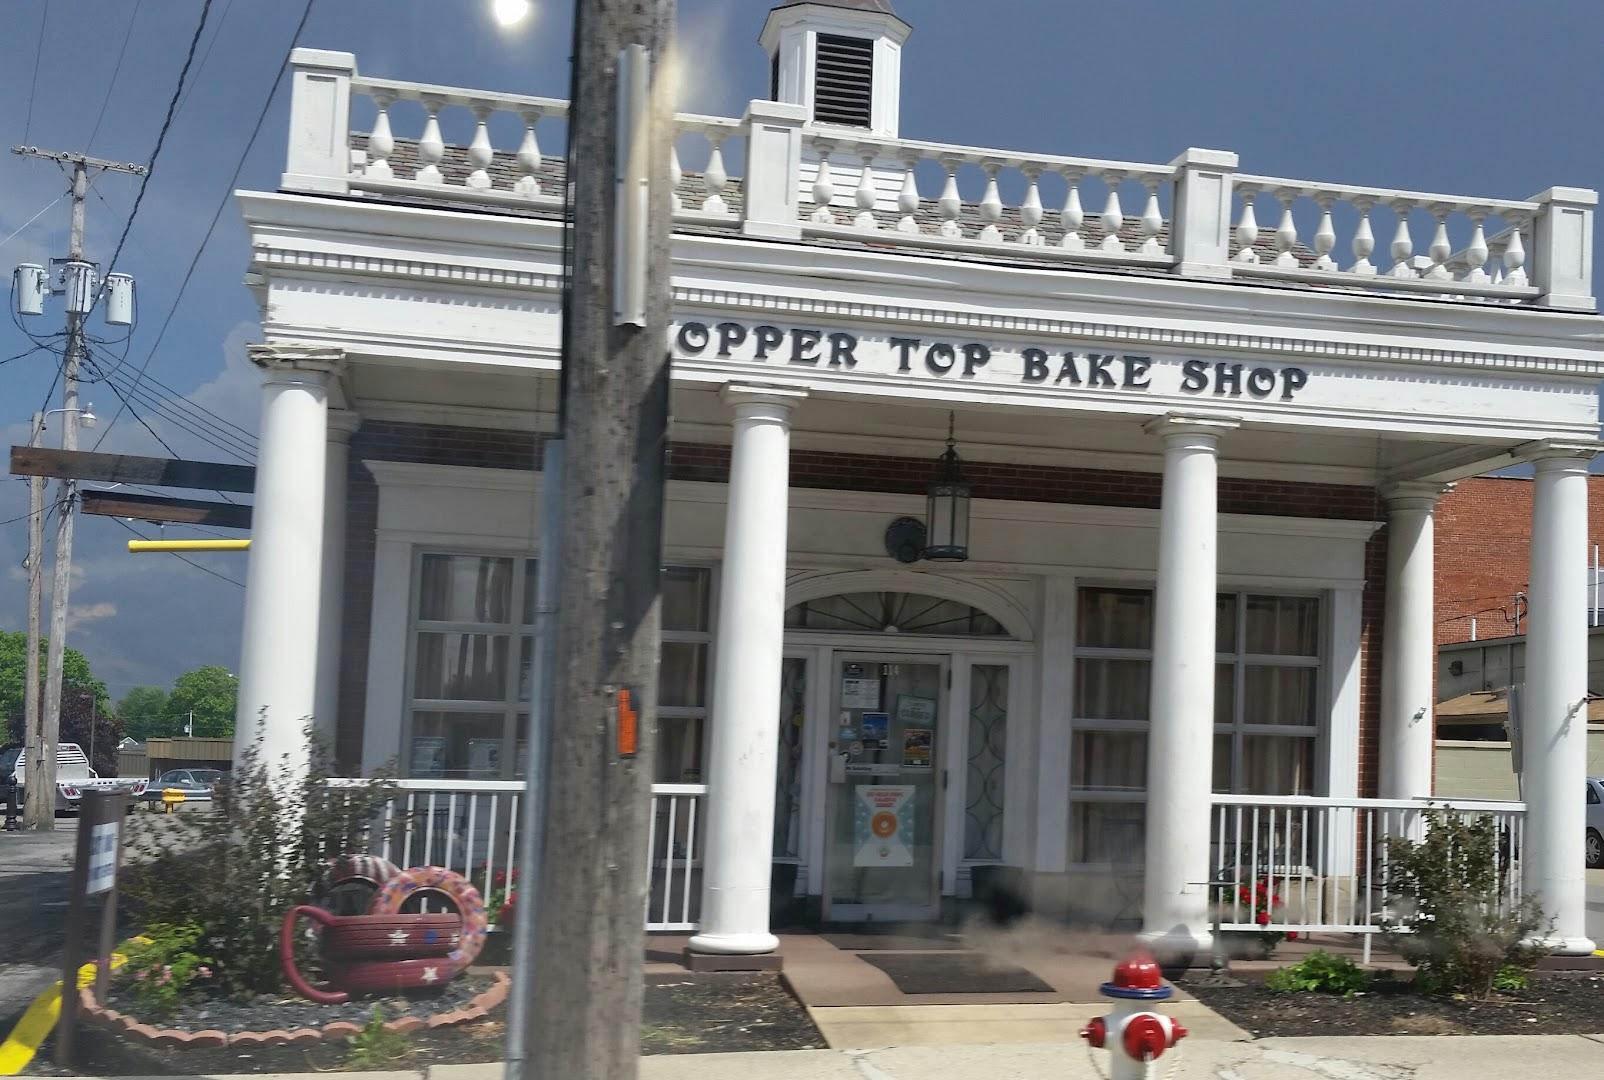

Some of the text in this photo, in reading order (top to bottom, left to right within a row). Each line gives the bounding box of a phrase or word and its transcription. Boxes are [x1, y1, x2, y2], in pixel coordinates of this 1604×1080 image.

[677, 321, 1308, 398] OPPER TOP BAKE SHOP
